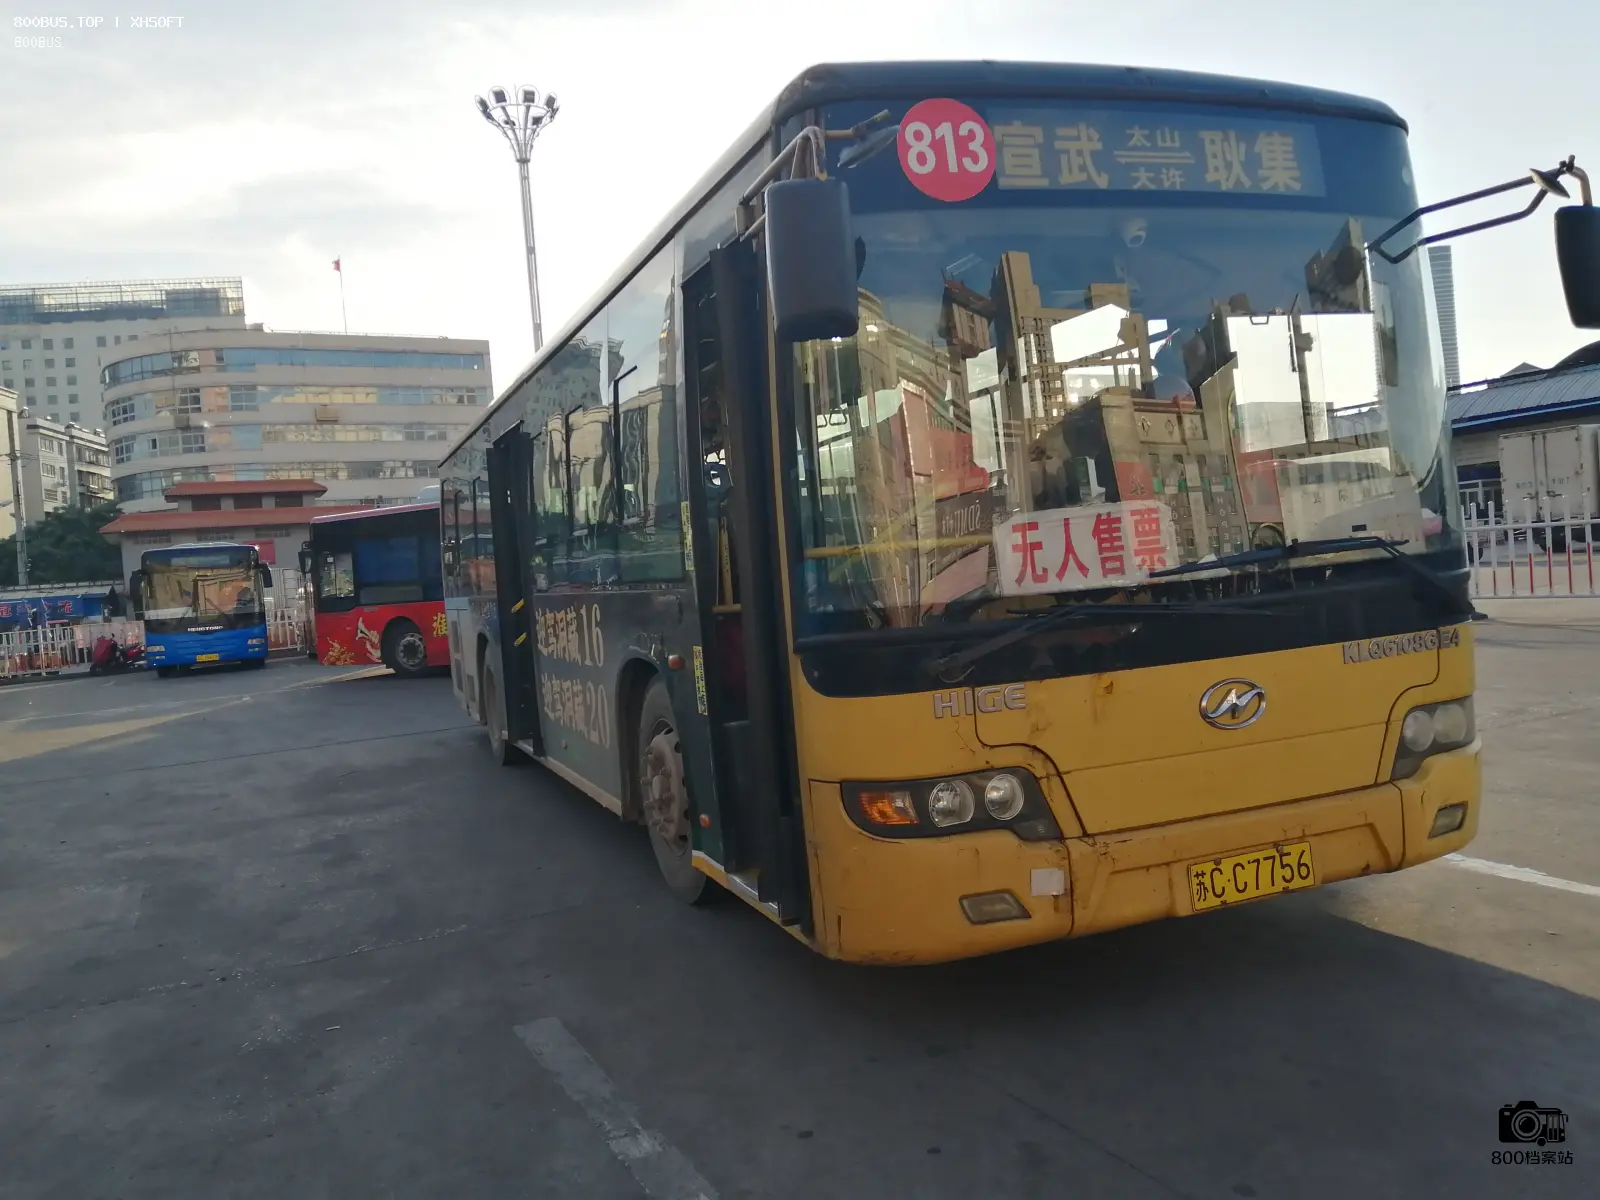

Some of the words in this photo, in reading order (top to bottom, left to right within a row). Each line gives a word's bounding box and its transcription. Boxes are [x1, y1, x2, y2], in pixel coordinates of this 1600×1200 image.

[904, 120, 989, 174] 813
[1125, 125, 1181, 149] 太山
[995, 120, 1109, 190] 宣武
[1199, 129, 1302, 192] 耿集
[1130, 167, 1186, 190] 大许
[1011, 507, 1168, 587] 无人售票
[1343, 628, 1461, 664] KLQ6108GE4
[933, 684, 1026, 719] HIGE
